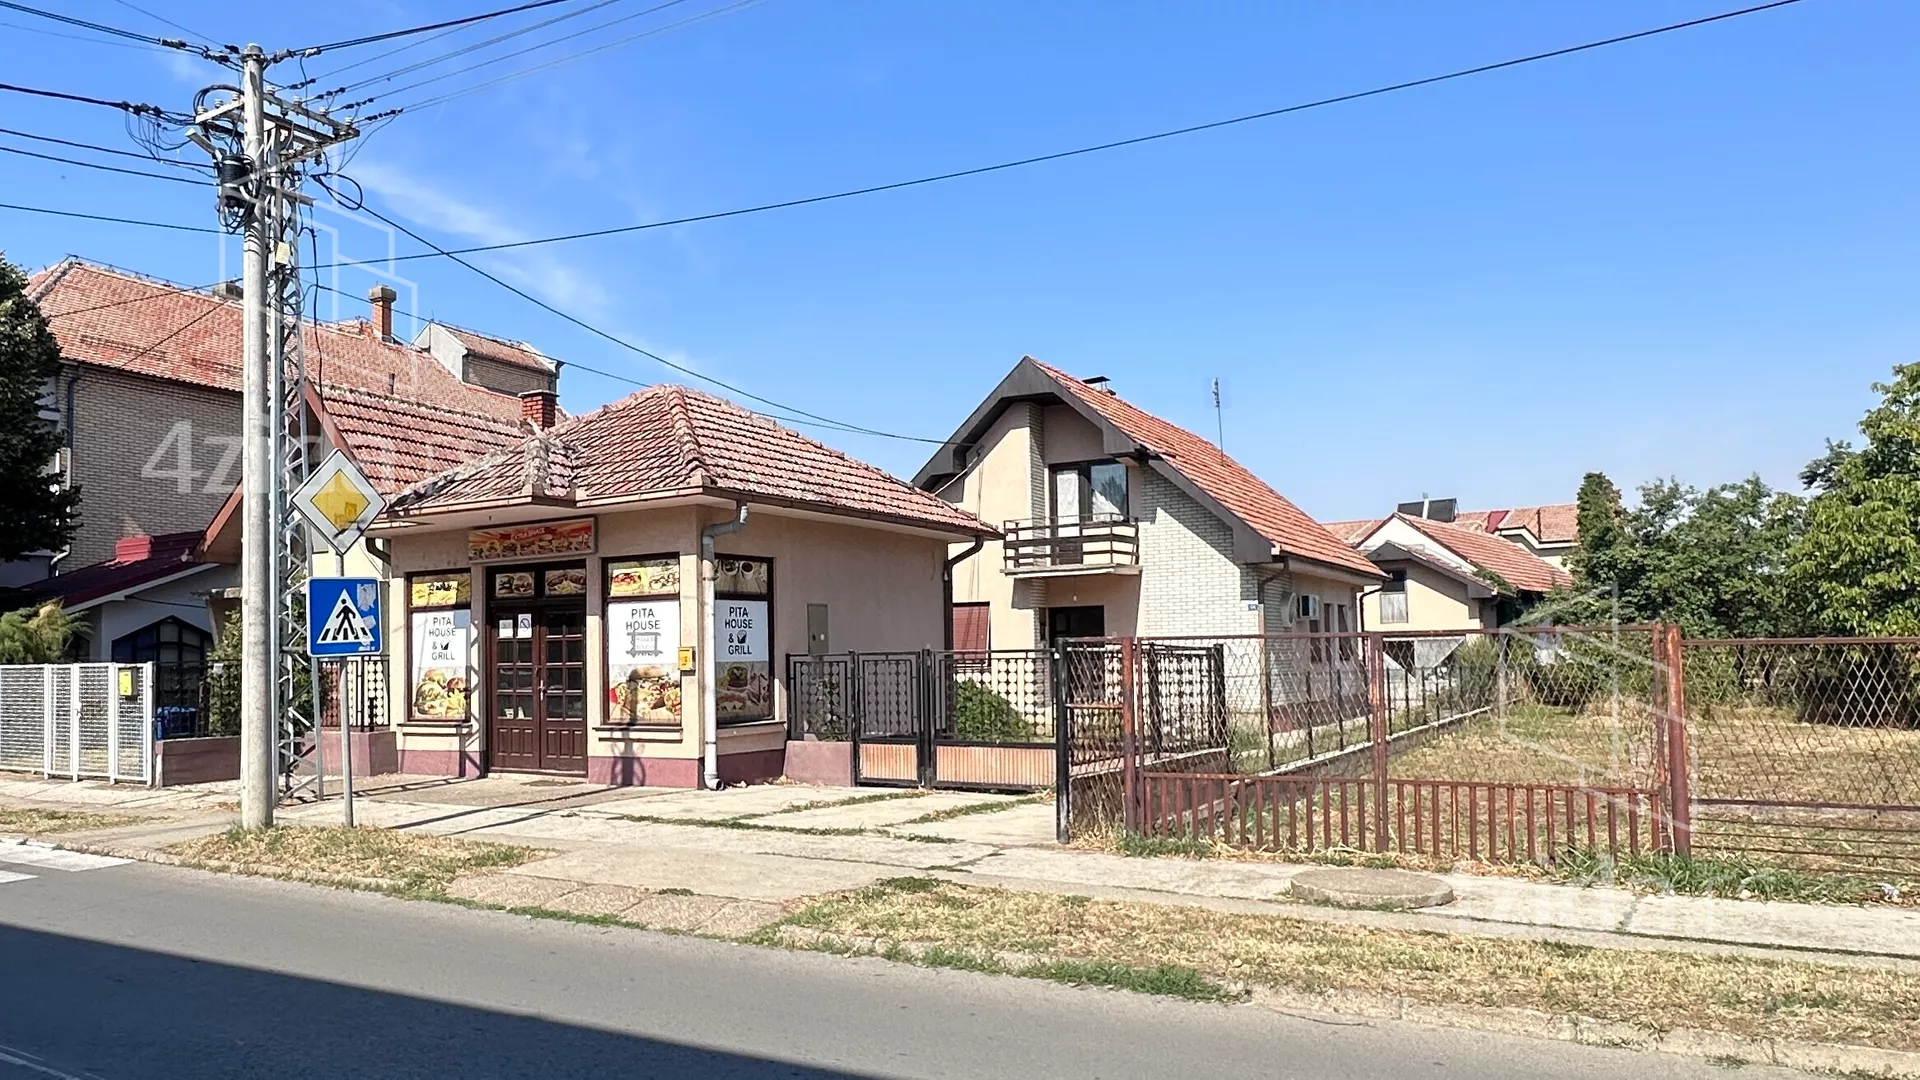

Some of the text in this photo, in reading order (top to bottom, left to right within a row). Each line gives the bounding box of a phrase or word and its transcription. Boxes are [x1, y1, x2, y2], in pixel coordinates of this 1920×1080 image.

[631, 608, 655, 619] PITA
[729, 606, 749, 618] PITA
[433, 617, 452, 626] PITA
[626, 620, 661, 631] HOUSE
[725, 619, 753, 629] HOUSE
[429, 628, 457, 637] HOUSE
[728, 632, 735, 643] &
[432, 641, 438, 651] &
[728, 645, 752, 655] GRILL
[431, 652, 456, 661] GRILL
